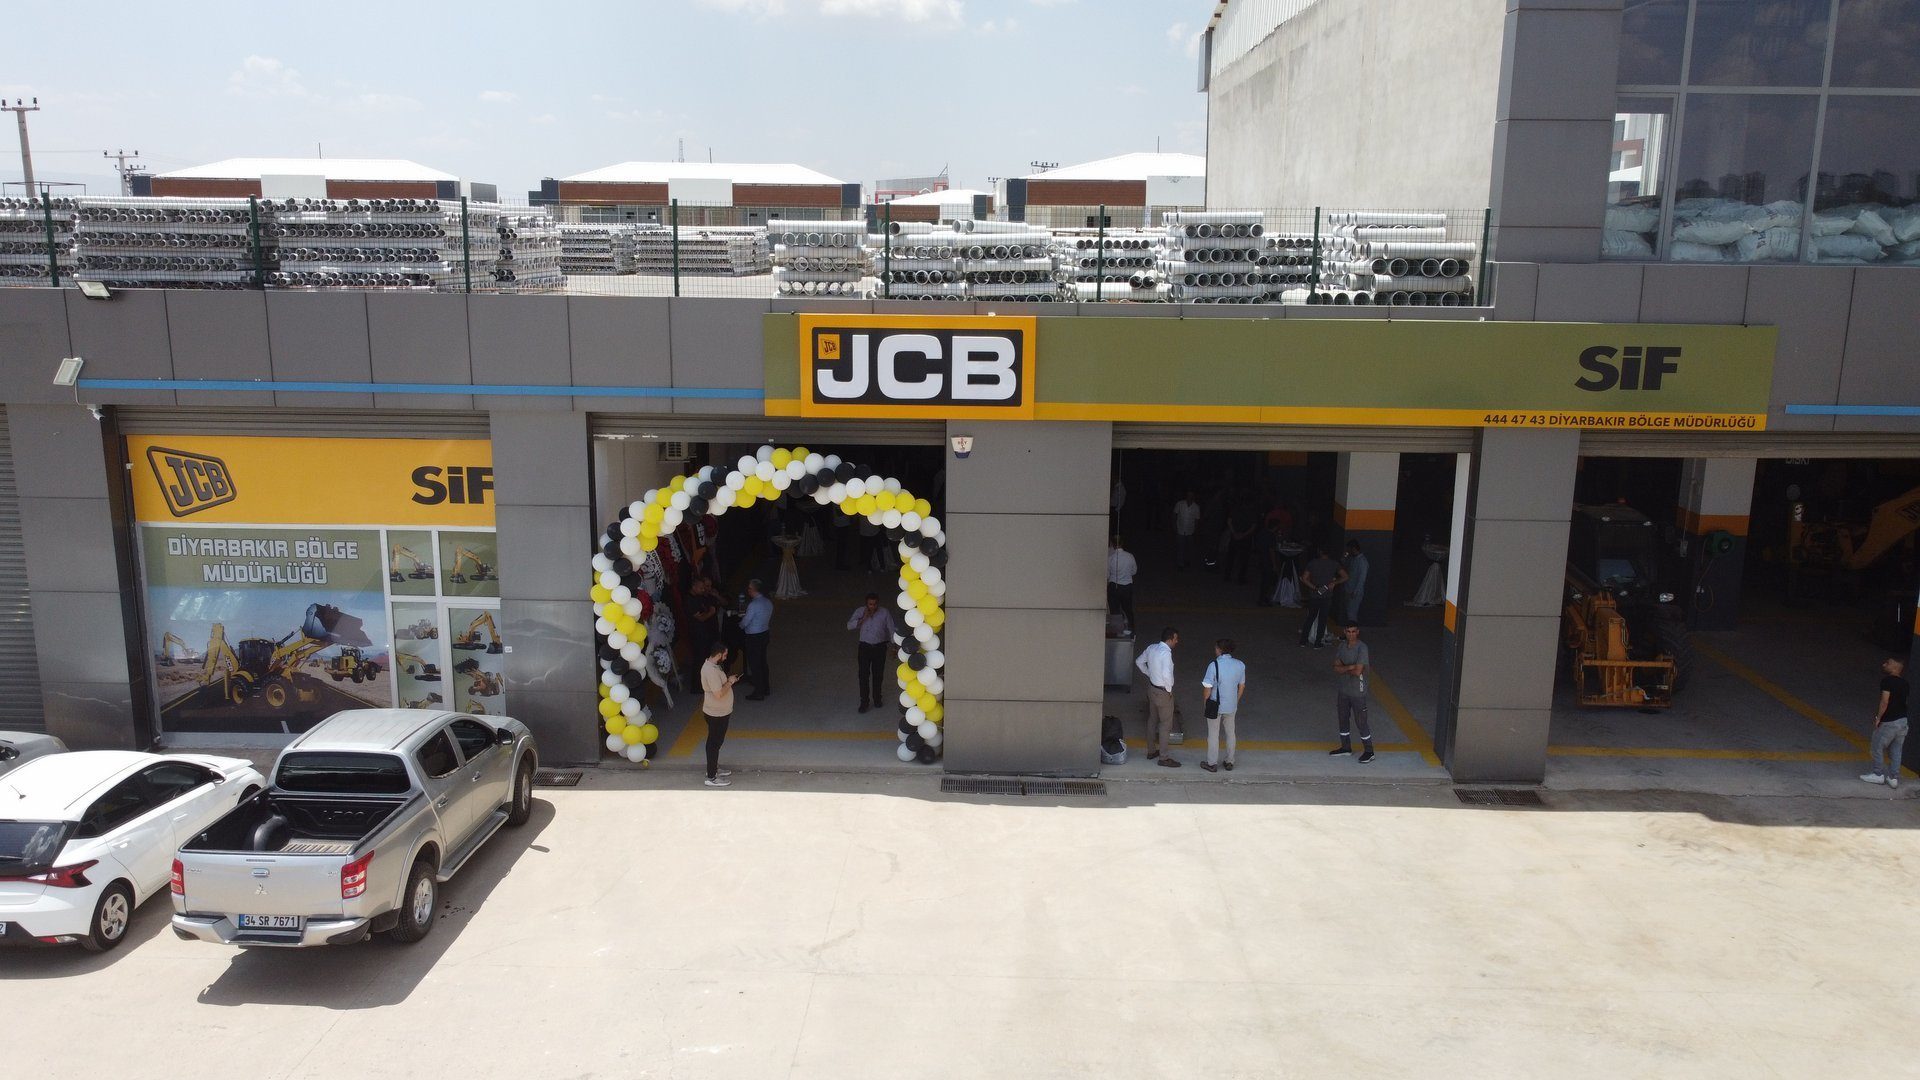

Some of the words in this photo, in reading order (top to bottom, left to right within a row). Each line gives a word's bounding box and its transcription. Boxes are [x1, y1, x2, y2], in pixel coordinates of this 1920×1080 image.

[817, 334, 1017, 400] JCB
[1483, 415, 1508, 425] 444
[1511, 415, 1527, 425] 47
[1529, 415, 1546, 425] 43
[1549, 413, 1625, 427] DİYARBAKIR
[1629, 414, 1671, 428] BÖLGE
[1673, 415, 1756, 429] MÜDÜRLÜĞÜ
[165, 456, 229, 507] JCB
[167, 533, 289, 558] DİYARBAKIR
[294, 536, 359, 560] BÖLGE
[202, 560, 328, 585] MÜDÜRLÜĞÜ
[245, 915, 256, 926] 34
[258, 915, 270, 926] SR
[273, 916, 295, 927] 7671
